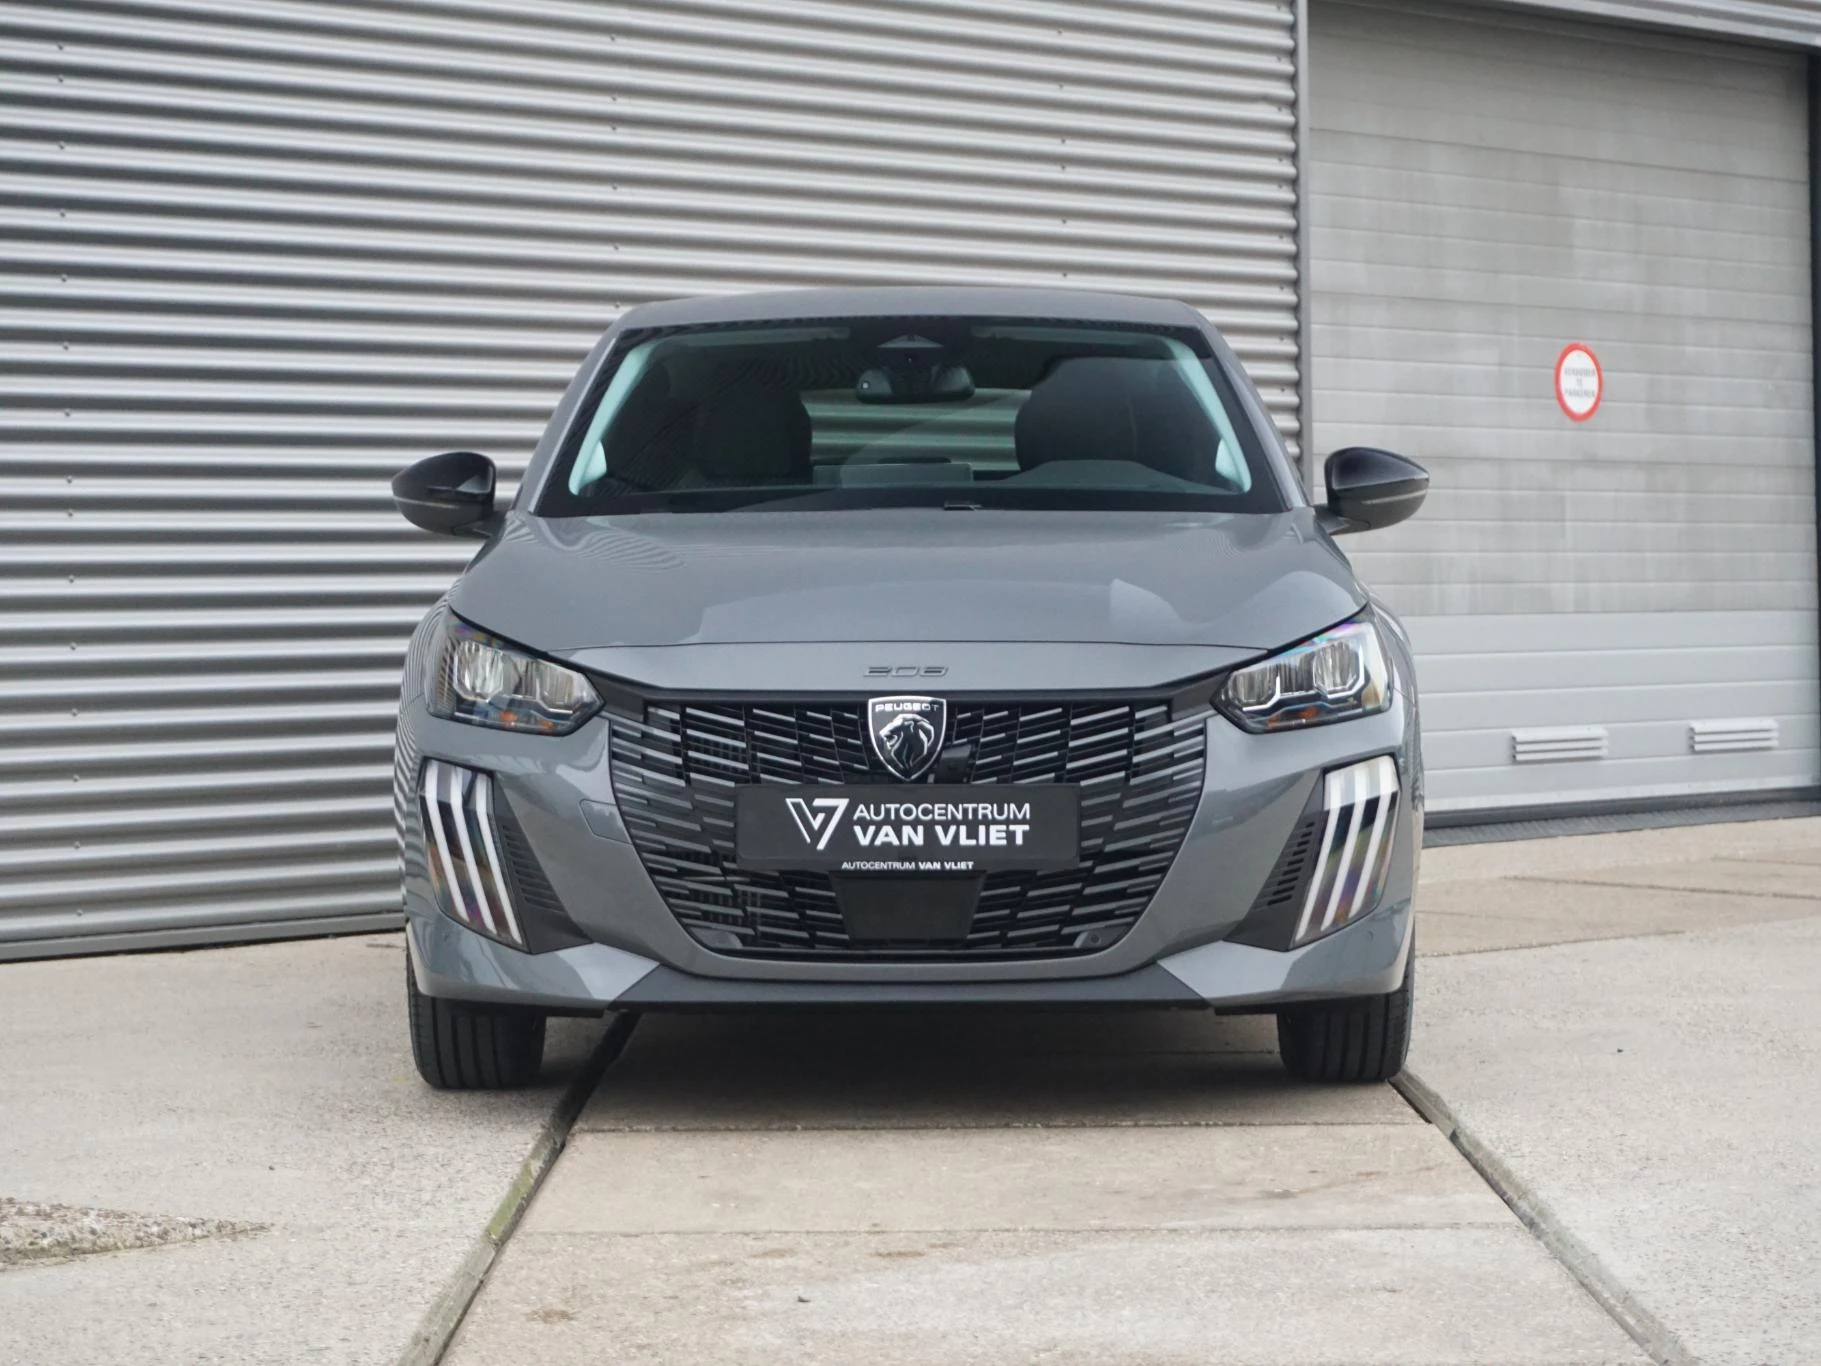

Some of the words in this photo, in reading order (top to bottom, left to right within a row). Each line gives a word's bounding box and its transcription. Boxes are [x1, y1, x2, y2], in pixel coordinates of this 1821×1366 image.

[875, 702, 939, 712] PEUGEOT
[853, 803, 1030, 821] AUTOCENTRUM
[853, 825, 925, 846] VAN
[935, 825, 1030, 846] VLIET
[841, 861, 916, 870] AUTOCENTRUM
[918, 861, 941, 870] VAN
[944, 861, 974, 870] VLIET
